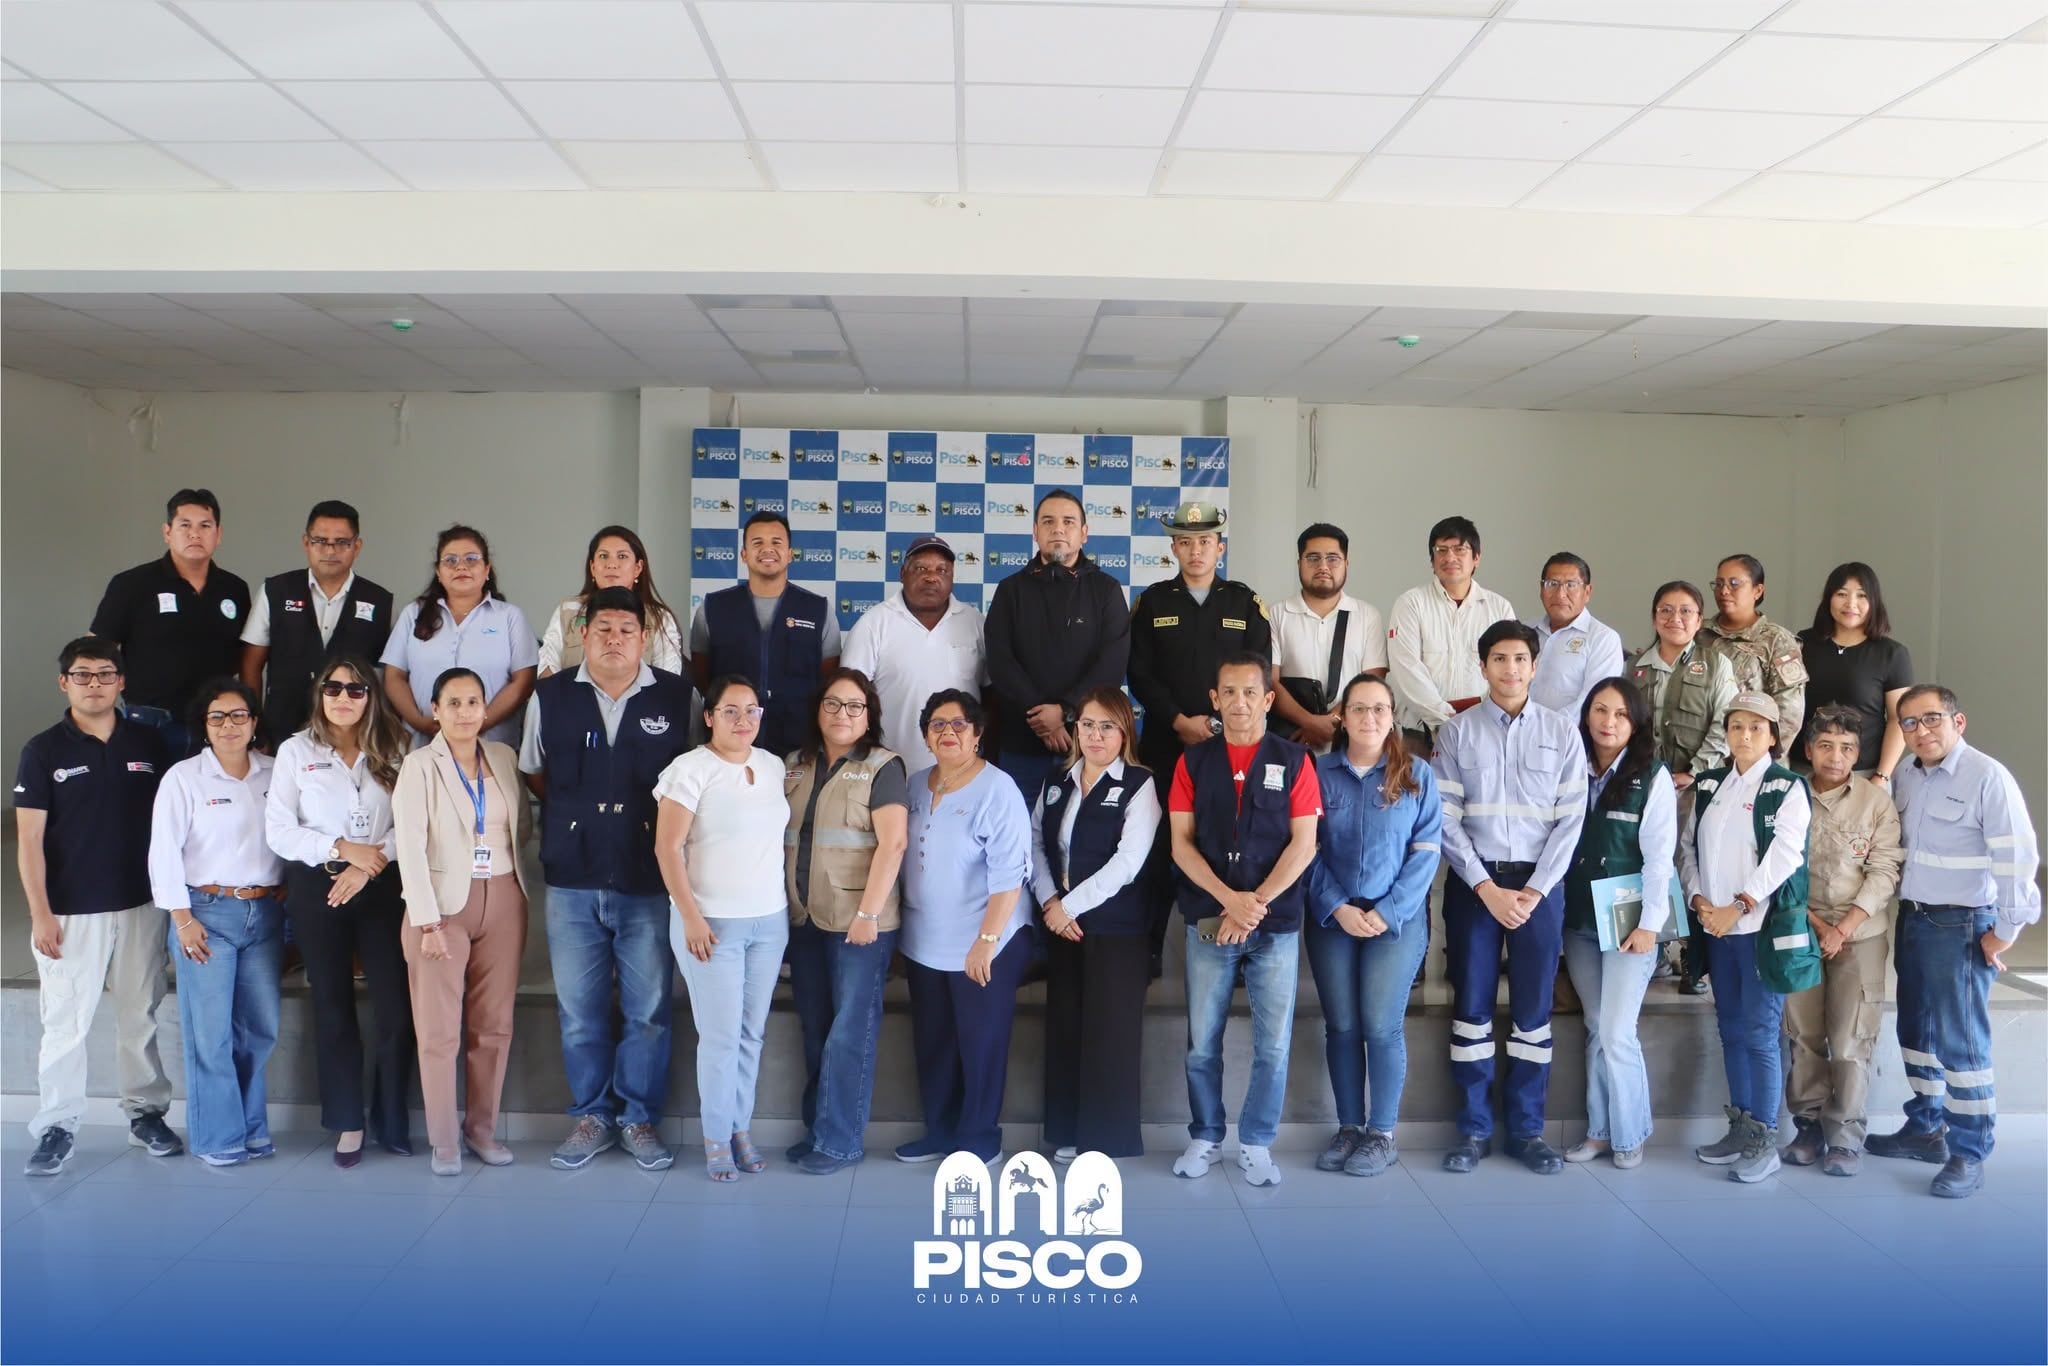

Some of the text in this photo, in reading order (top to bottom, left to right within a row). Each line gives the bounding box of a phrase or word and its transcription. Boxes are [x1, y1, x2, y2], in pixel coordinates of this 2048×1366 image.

[709, 452, 737, 461] PISCO
[807, 454, 835, 463] PISCO
[905, 455, 933, 465] PISCO
[1101, 459, 1129, 469] PISCO
[757, 503, 785, 512] PISCO
[855, 504, 883, 514] PISCO
[954, 506, 982, 515] PISCO
[707, 551, 735, 561] PISCO
[805, 552, 833, 562] PISCO
[1100, 558, 1127, 568] PISCO
